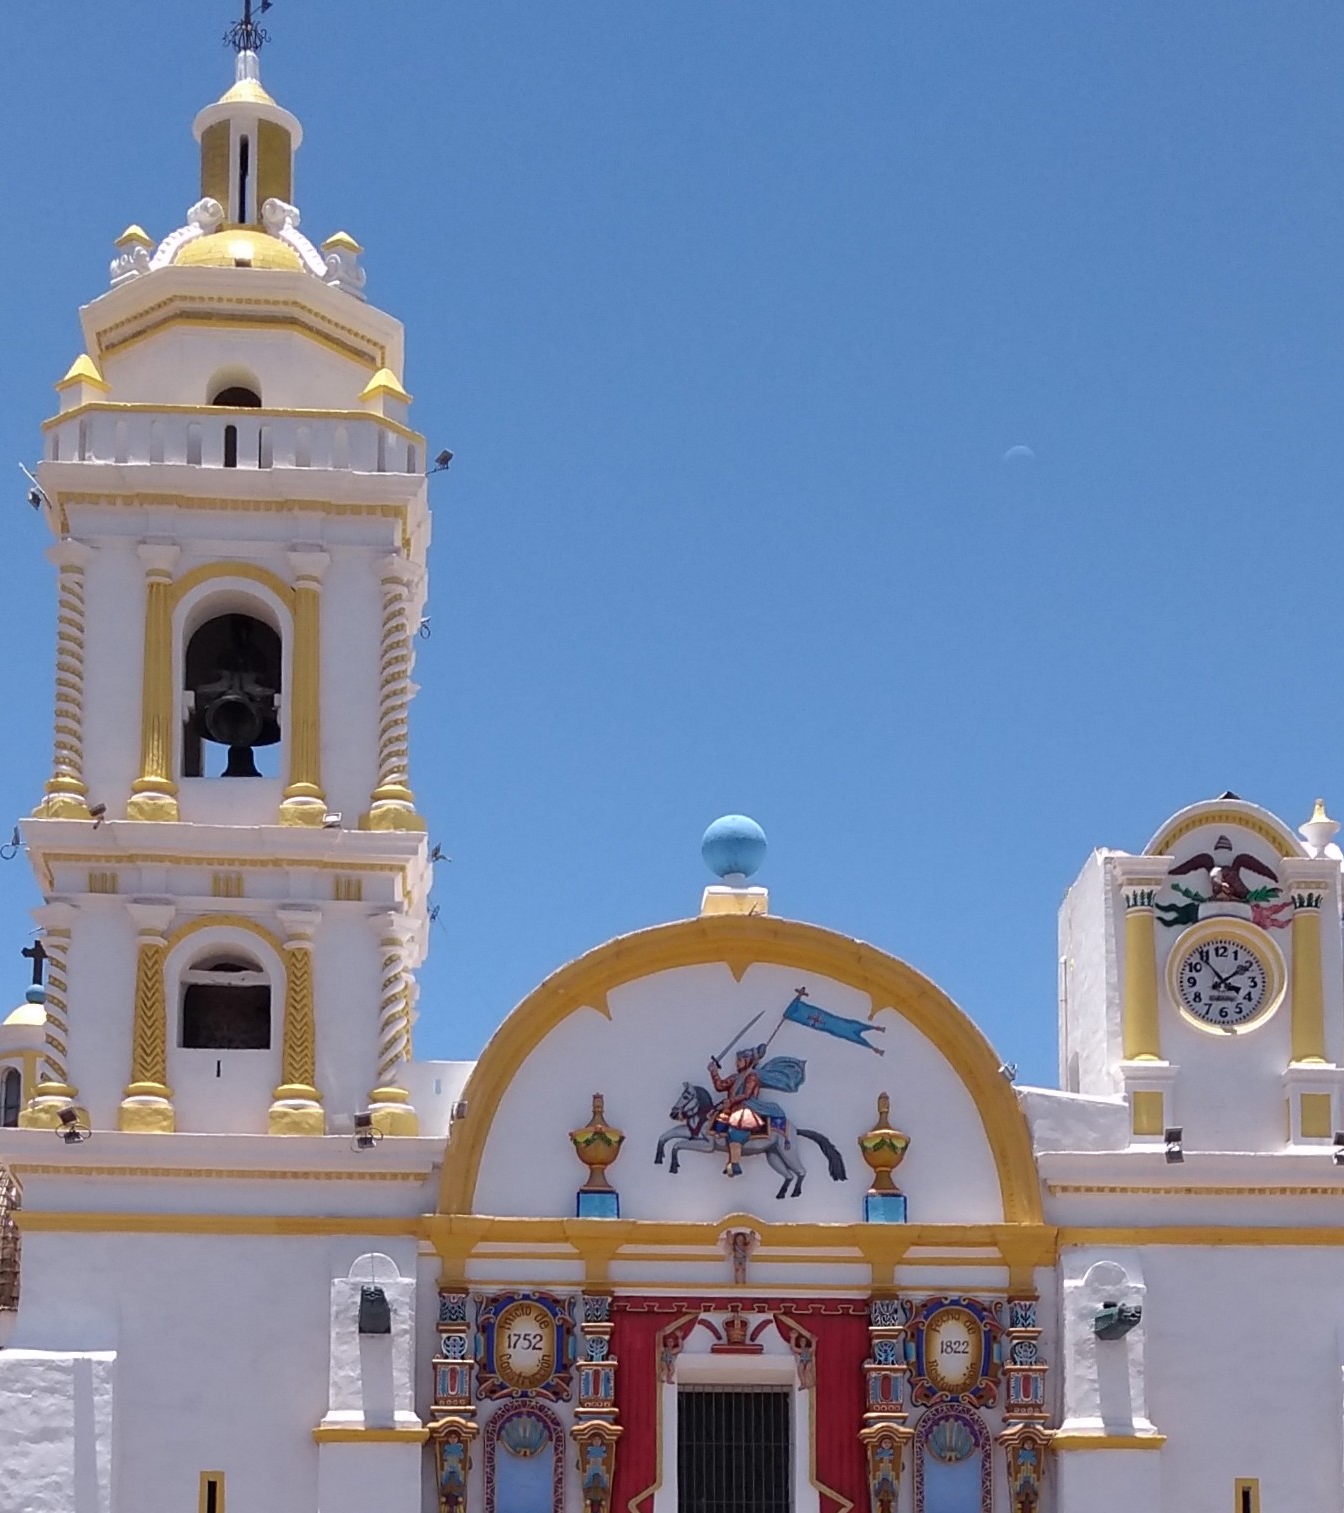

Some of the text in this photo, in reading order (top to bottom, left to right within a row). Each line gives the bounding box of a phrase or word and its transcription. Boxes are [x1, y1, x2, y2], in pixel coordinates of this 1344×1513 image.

[1214, 945, 1228, 958] 12
[1232, 949, 1239, 961] 1
[1187, 961, 1203, 973] 10
[1187, 976, 1197, 988] 9
[1247, 975, 1258, 988] 3
[1192, 991, 1202, 1003] 8
[1242, 991, 1253, 1002] 4
[1203, 1003, 1213, 1015] 7
[1218, 1006, 1229, 1018] 6
[1233, 1002, 1243, 1014] 5
[534, 1312, 551, 1330] de
[930, 1311, 977, 1335] Fecha de
[507, 1333, 544, 1351] 1752
[940, 1340, 970, 1355] 1822
